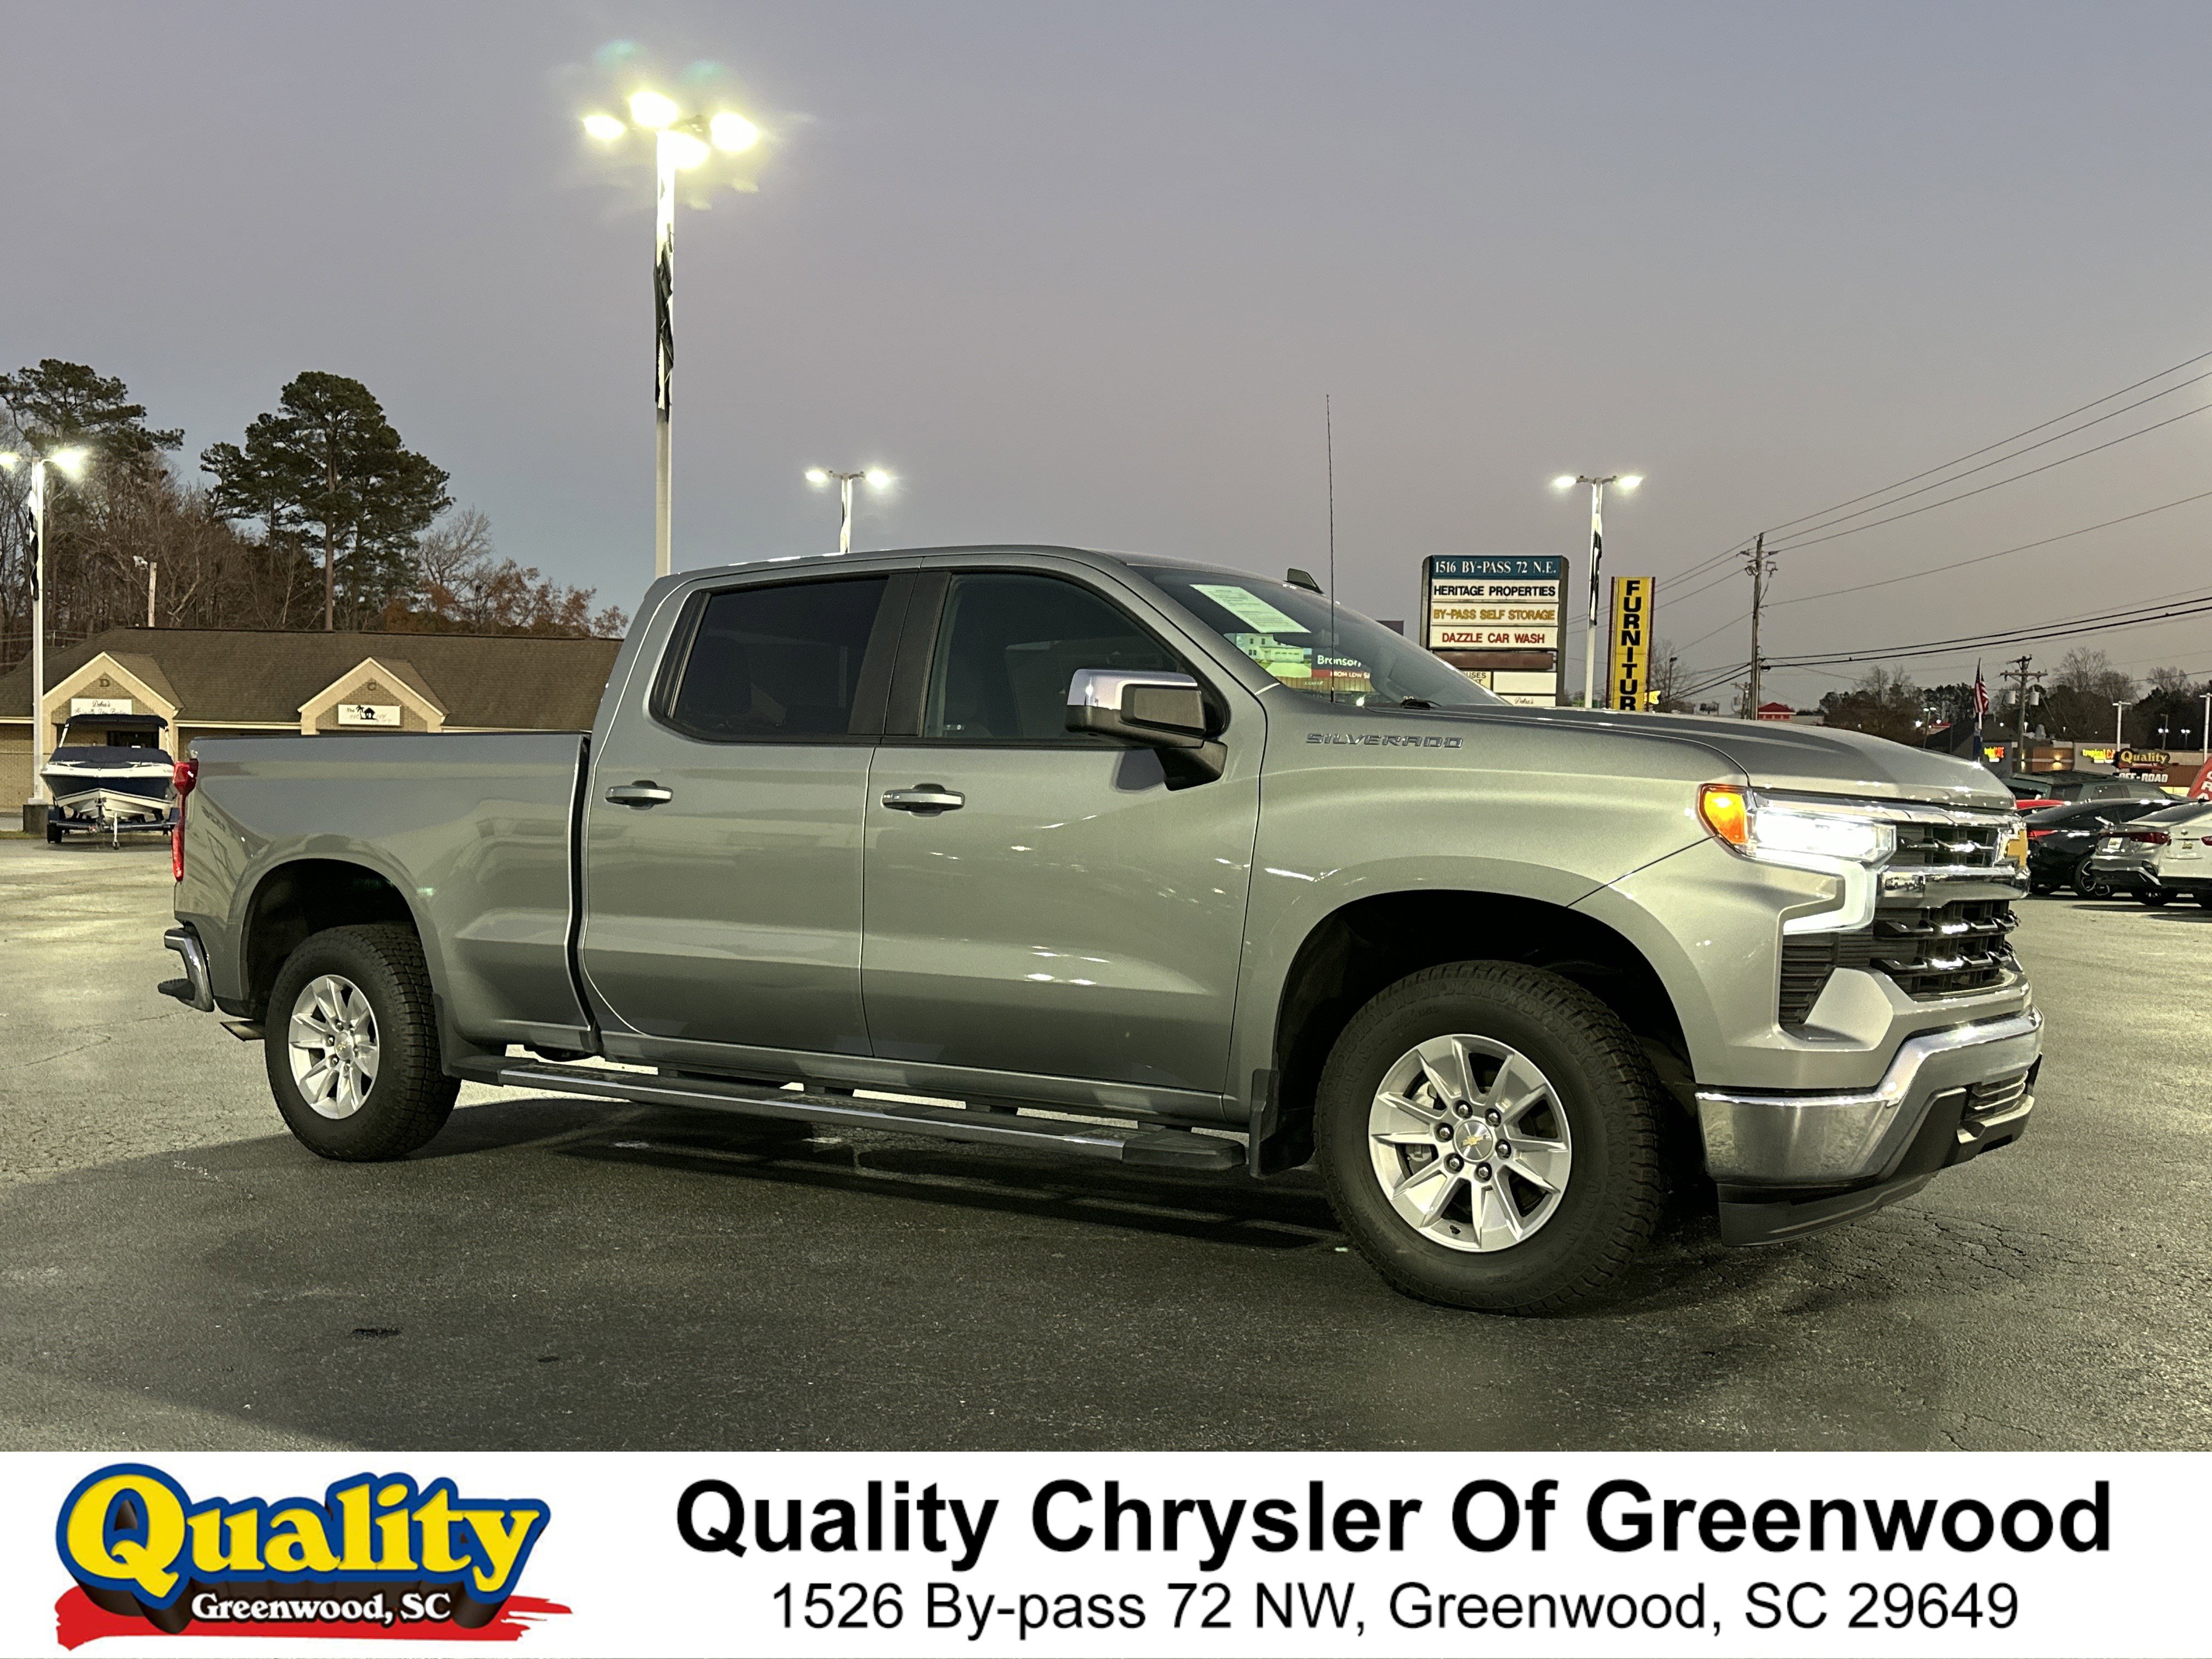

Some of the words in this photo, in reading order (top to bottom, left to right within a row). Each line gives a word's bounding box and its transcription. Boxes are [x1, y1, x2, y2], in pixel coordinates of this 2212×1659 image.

[1435, 561, 1456, 573] 1516
[1462, 561, 1511, 573] BY-PASS
[1516, 561, 1527, 573] 72
[1533, 561, 1556, 574] N.E.
[1434, 585, 1484, 596] HERITAGE
[1489, 585, 1555, 596] PROPERTIES
[1434, 608, 1476, 620] BY-PASS
[1480, 609, 1505, 620] SELF
[1508, 610, 1555, 620] STORAGE
[1442, 633, 1482, 643] DAZZLE
[1488, 633, 1509, 644] CAR
[1515, 633, 1545, 644] WASH
[99, 679, 110, 687] D
[1306, 733, 1463, 748] SILVERADO
[2121, 751, 2167, 765] Quality
